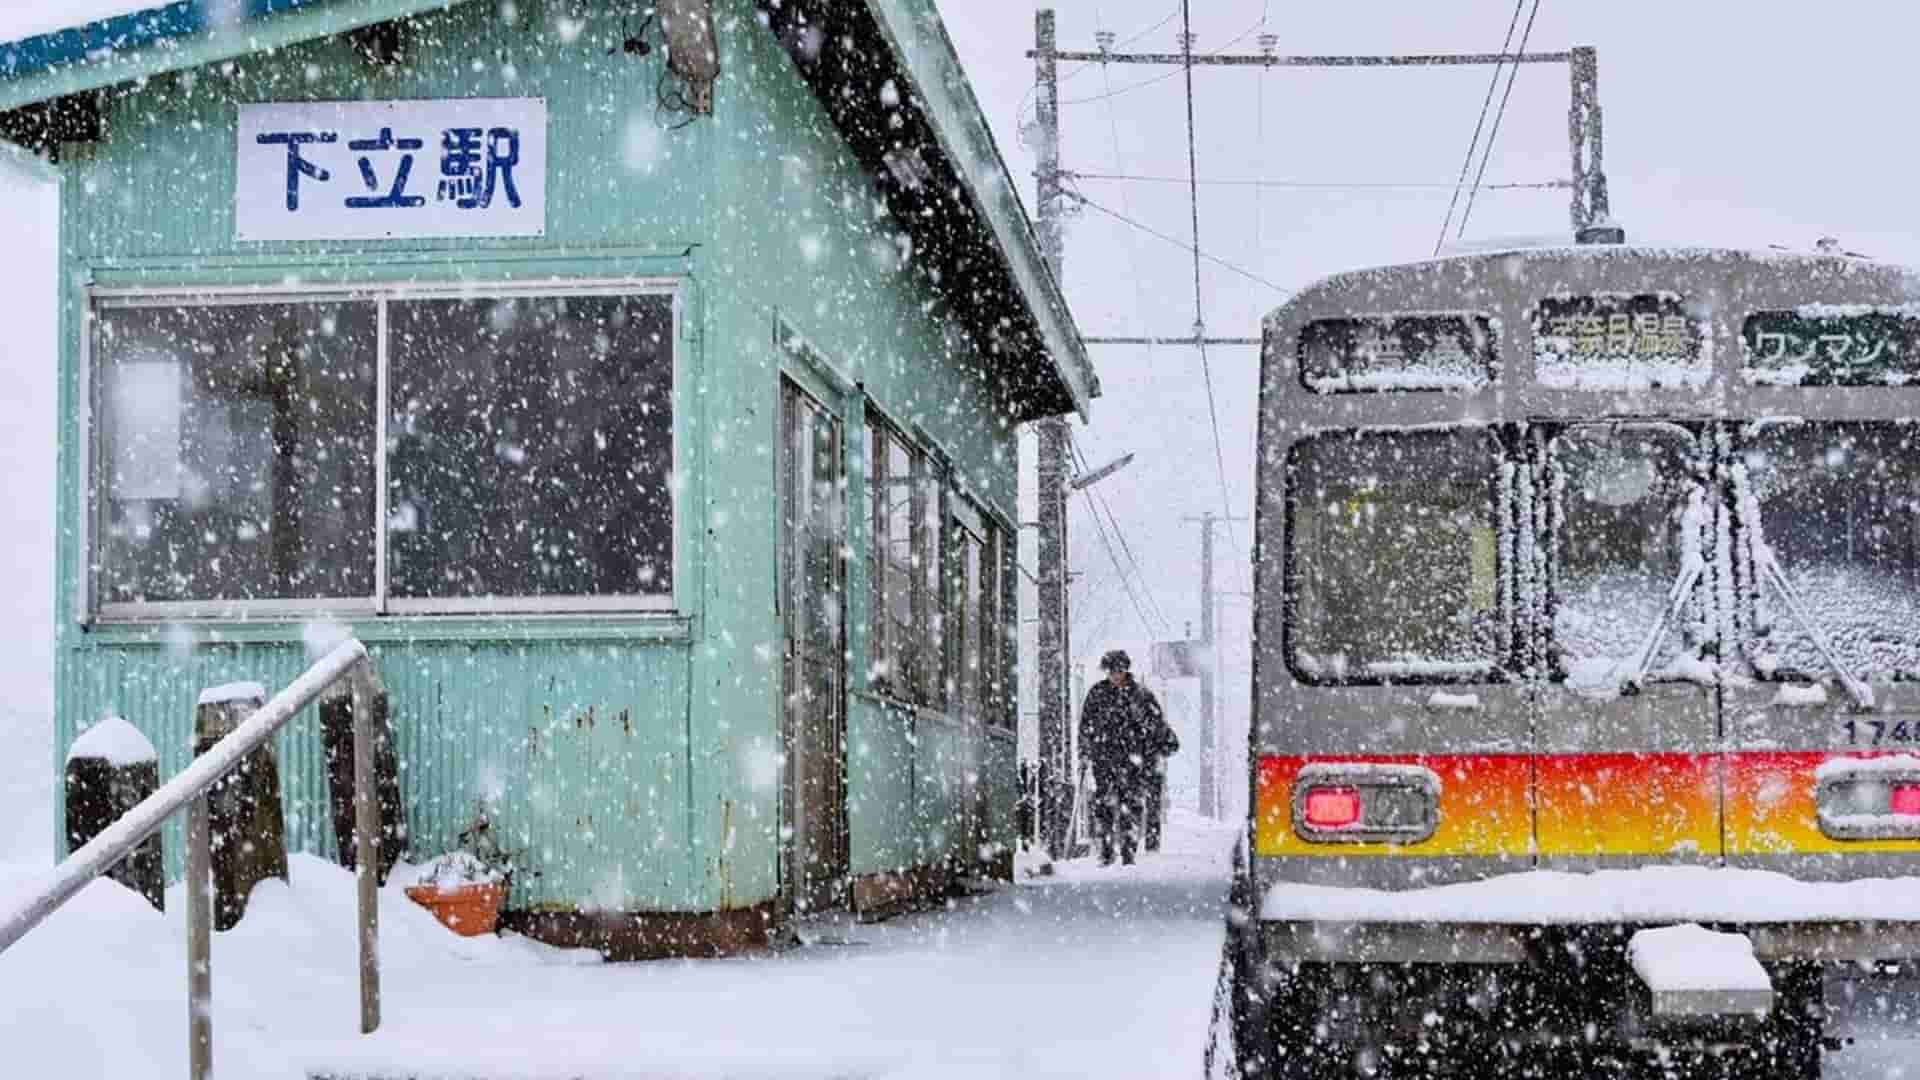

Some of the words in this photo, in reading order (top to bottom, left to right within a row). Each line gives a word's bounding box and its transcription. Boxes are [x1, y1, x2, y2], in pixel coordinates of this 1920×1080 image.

[256, 127, 521, 211] 下立駅
[1756, 331, 1886, 365] ワンマン
